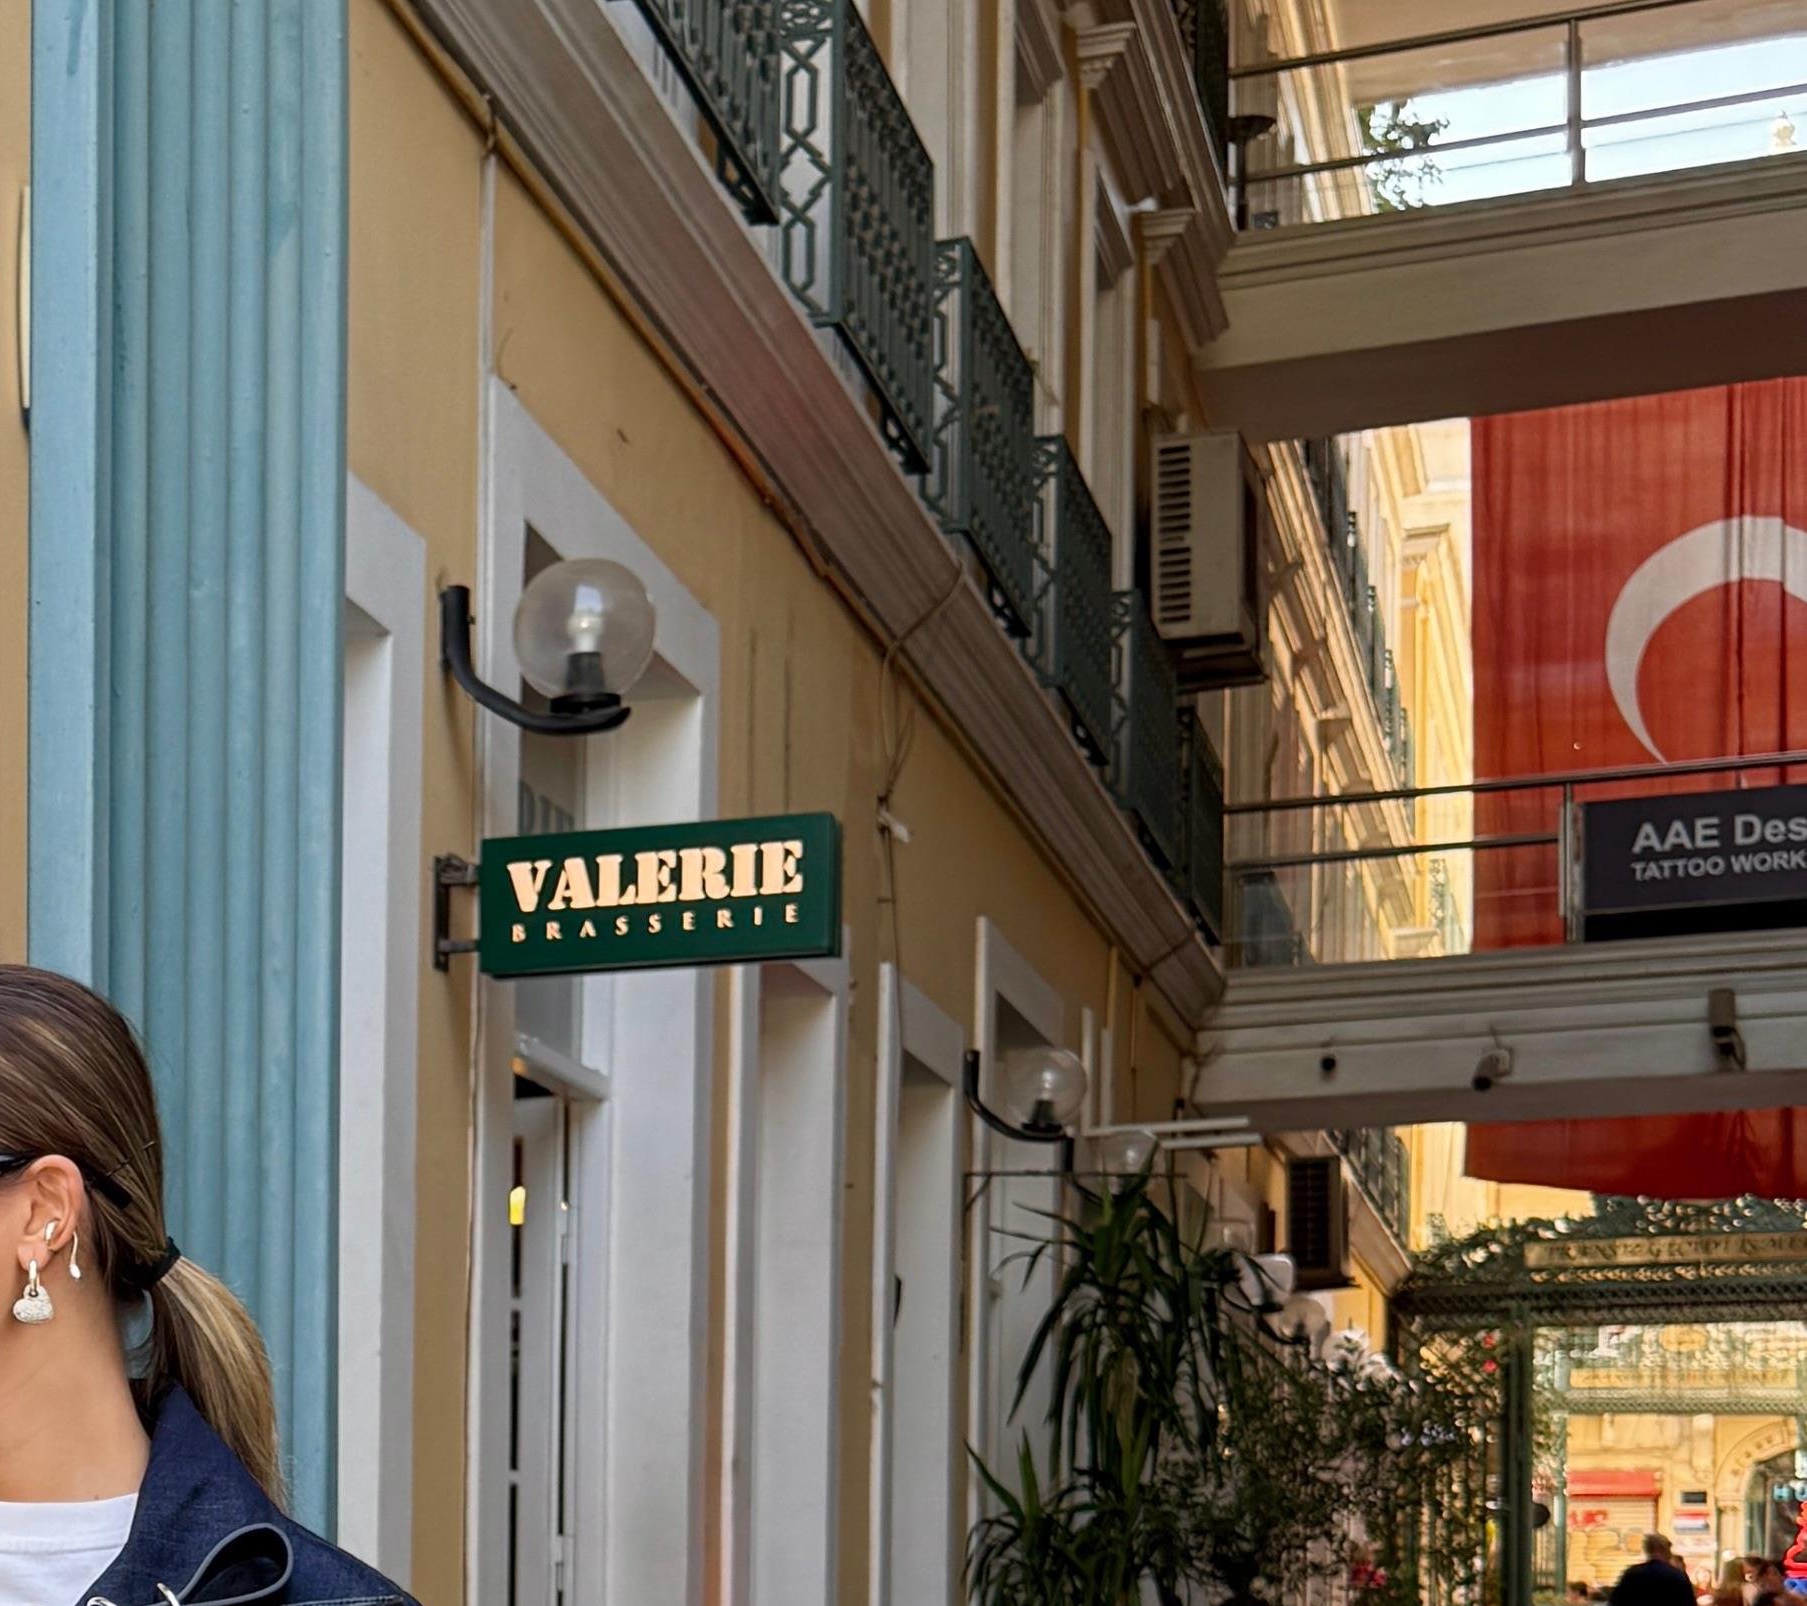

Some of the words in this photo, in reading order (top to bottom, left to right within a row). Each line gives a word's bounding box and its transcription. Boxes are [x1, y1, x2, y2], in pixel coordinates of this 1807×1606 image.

[1631, 816, 1722, 854] AAE
[507, 840, 803, 913] VALERIE
[1631, 855, 1726, 881] TATTOO
[511, 903, 799, 943] BRASSERIE
